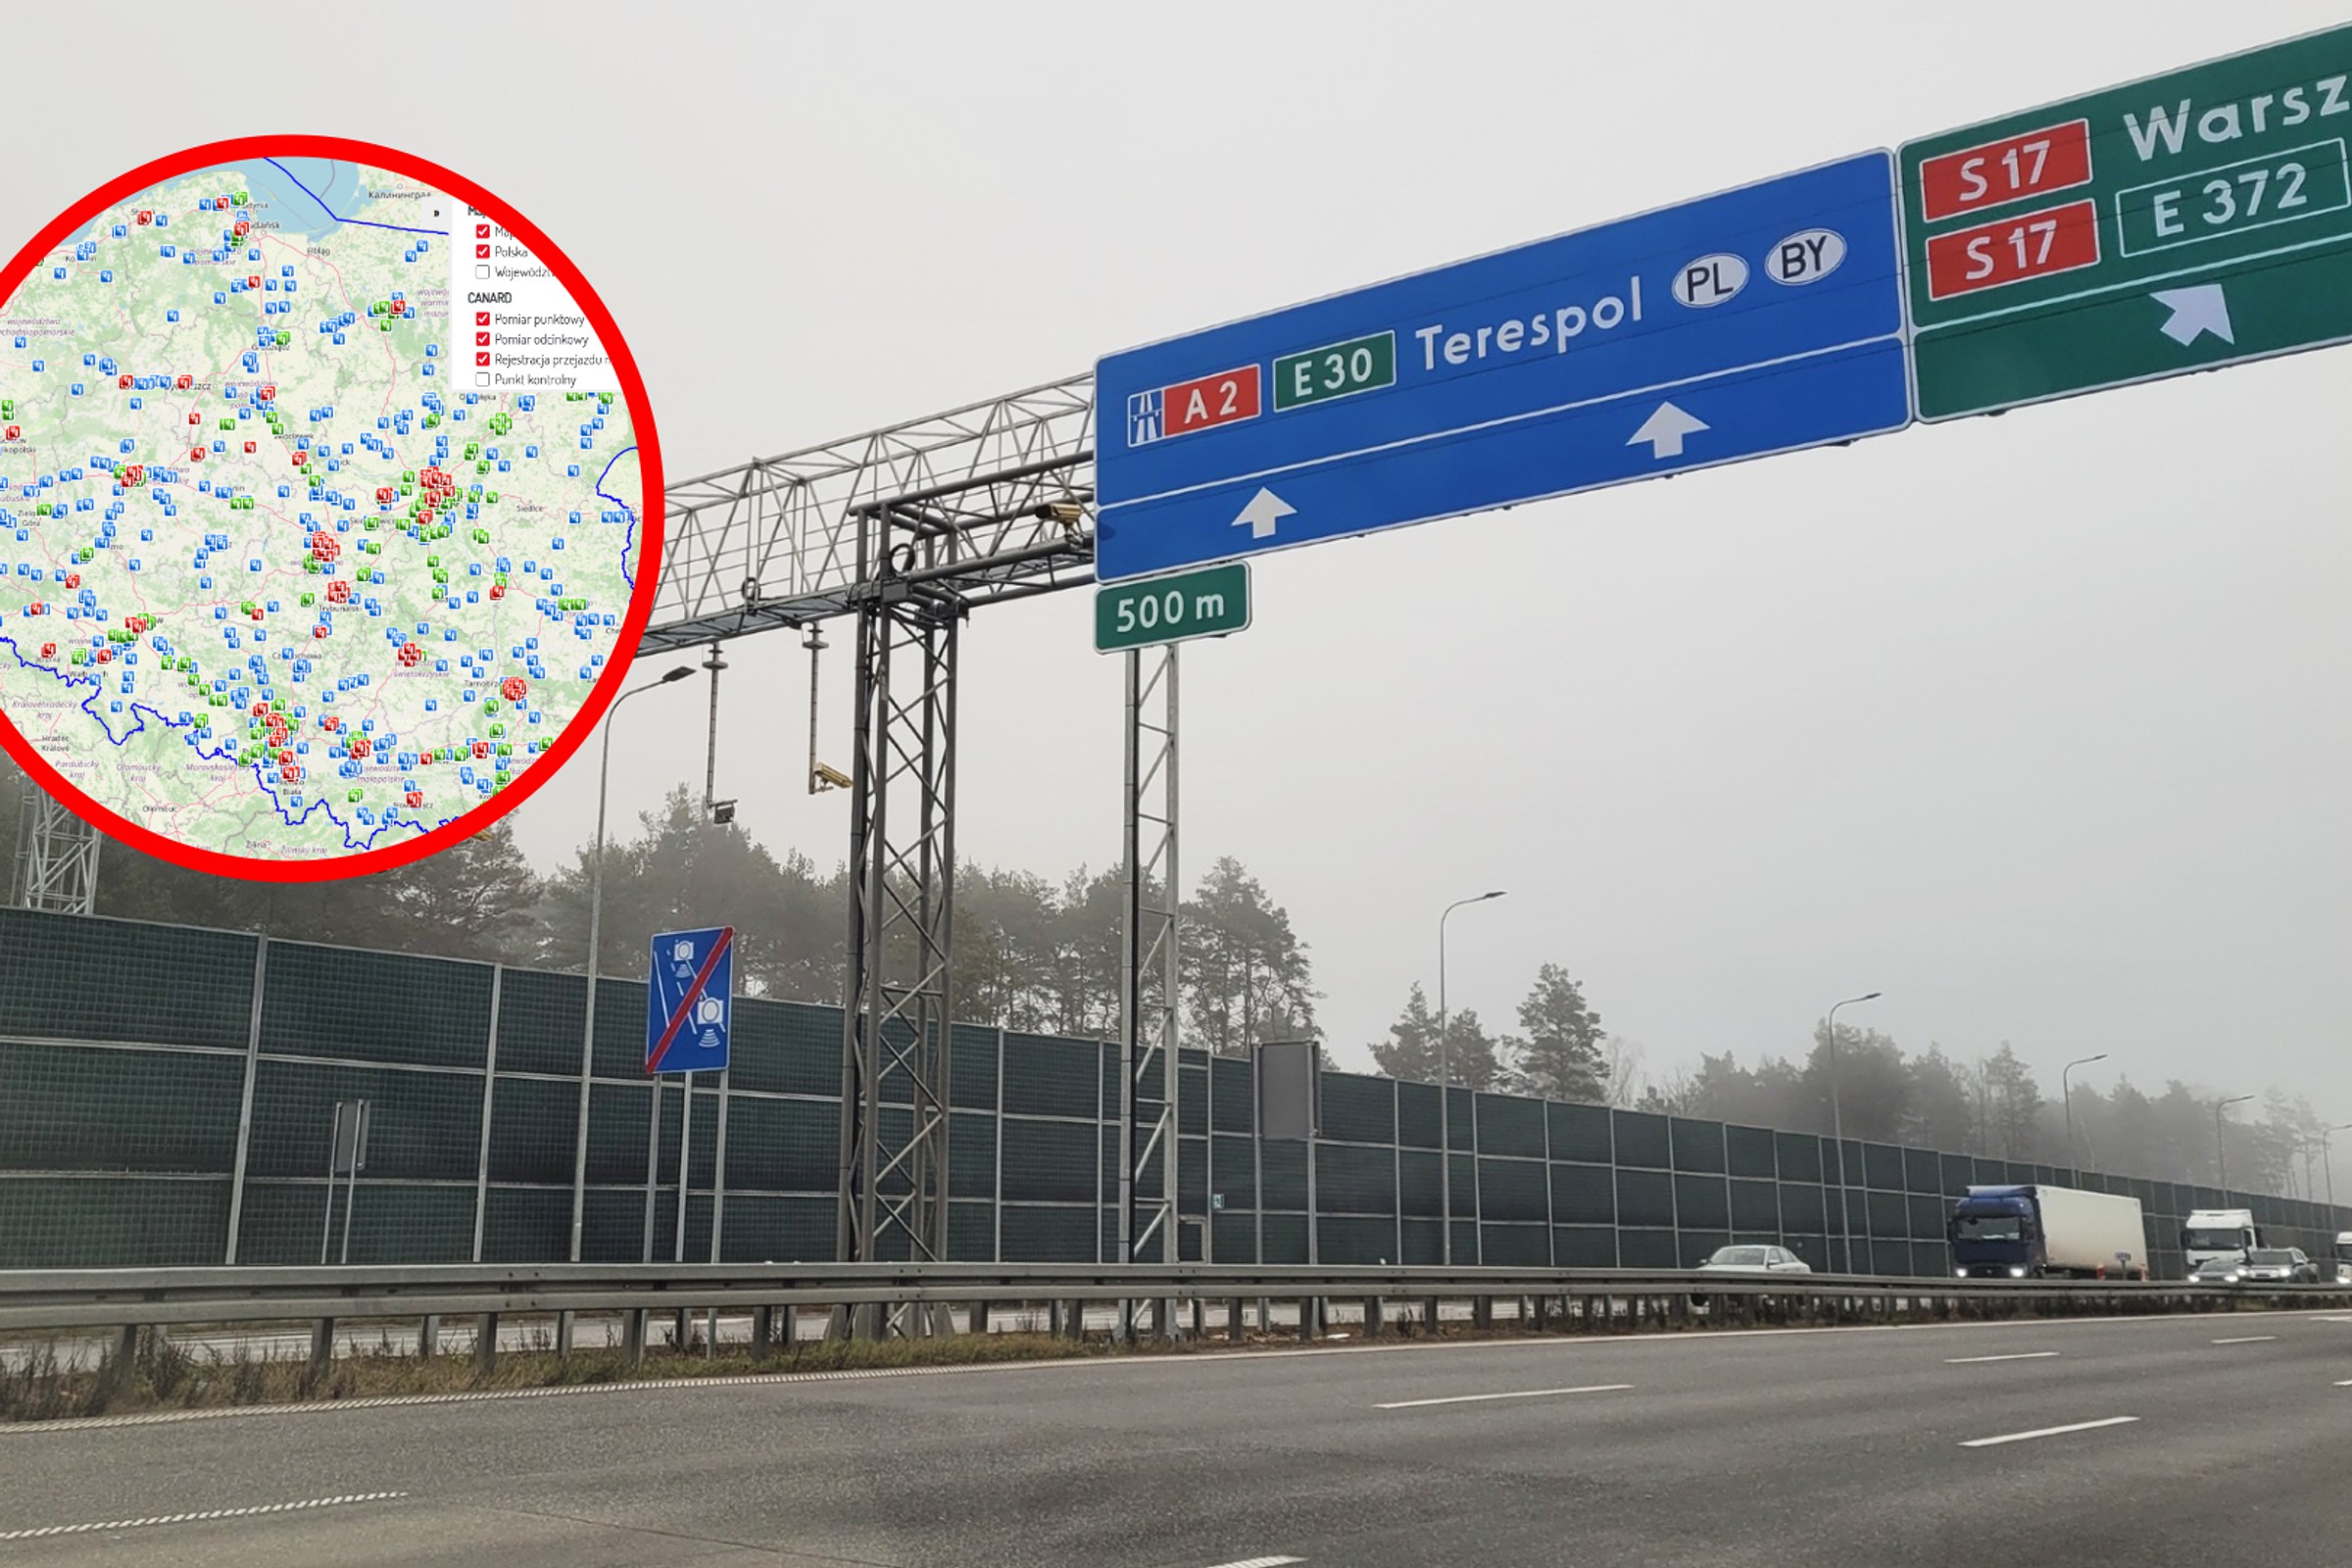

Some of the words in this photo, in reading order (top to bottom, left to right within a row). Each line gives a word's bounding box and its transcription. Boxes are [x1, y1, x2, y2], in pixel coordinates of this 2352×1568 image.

[2123, 74, 2351, 162] Warsz
[1960, 158, 1987, 202] S
[2001, 140, 2051, 188] 17
[2155, 190, 2184, 237] E
[2202, 163, 2308, 224] 372
[1781, 235, 1828, 279] BY
[1966, 235, 1993, 280] S
[2008, 220, 2057, 270] 17
[1686, 263, 1734, 302] PL
[1415, 274, 1642, 370] Terespol
[1295, 360, 1312, 398] E
[1323, 347, 1372, 390] 30
[1184, 388, 1209, 424] A
[1218, 380, 1238, 416] 2
[1116, 590, 1185, 633] 500
[1196, 593, 1224, 620] m
